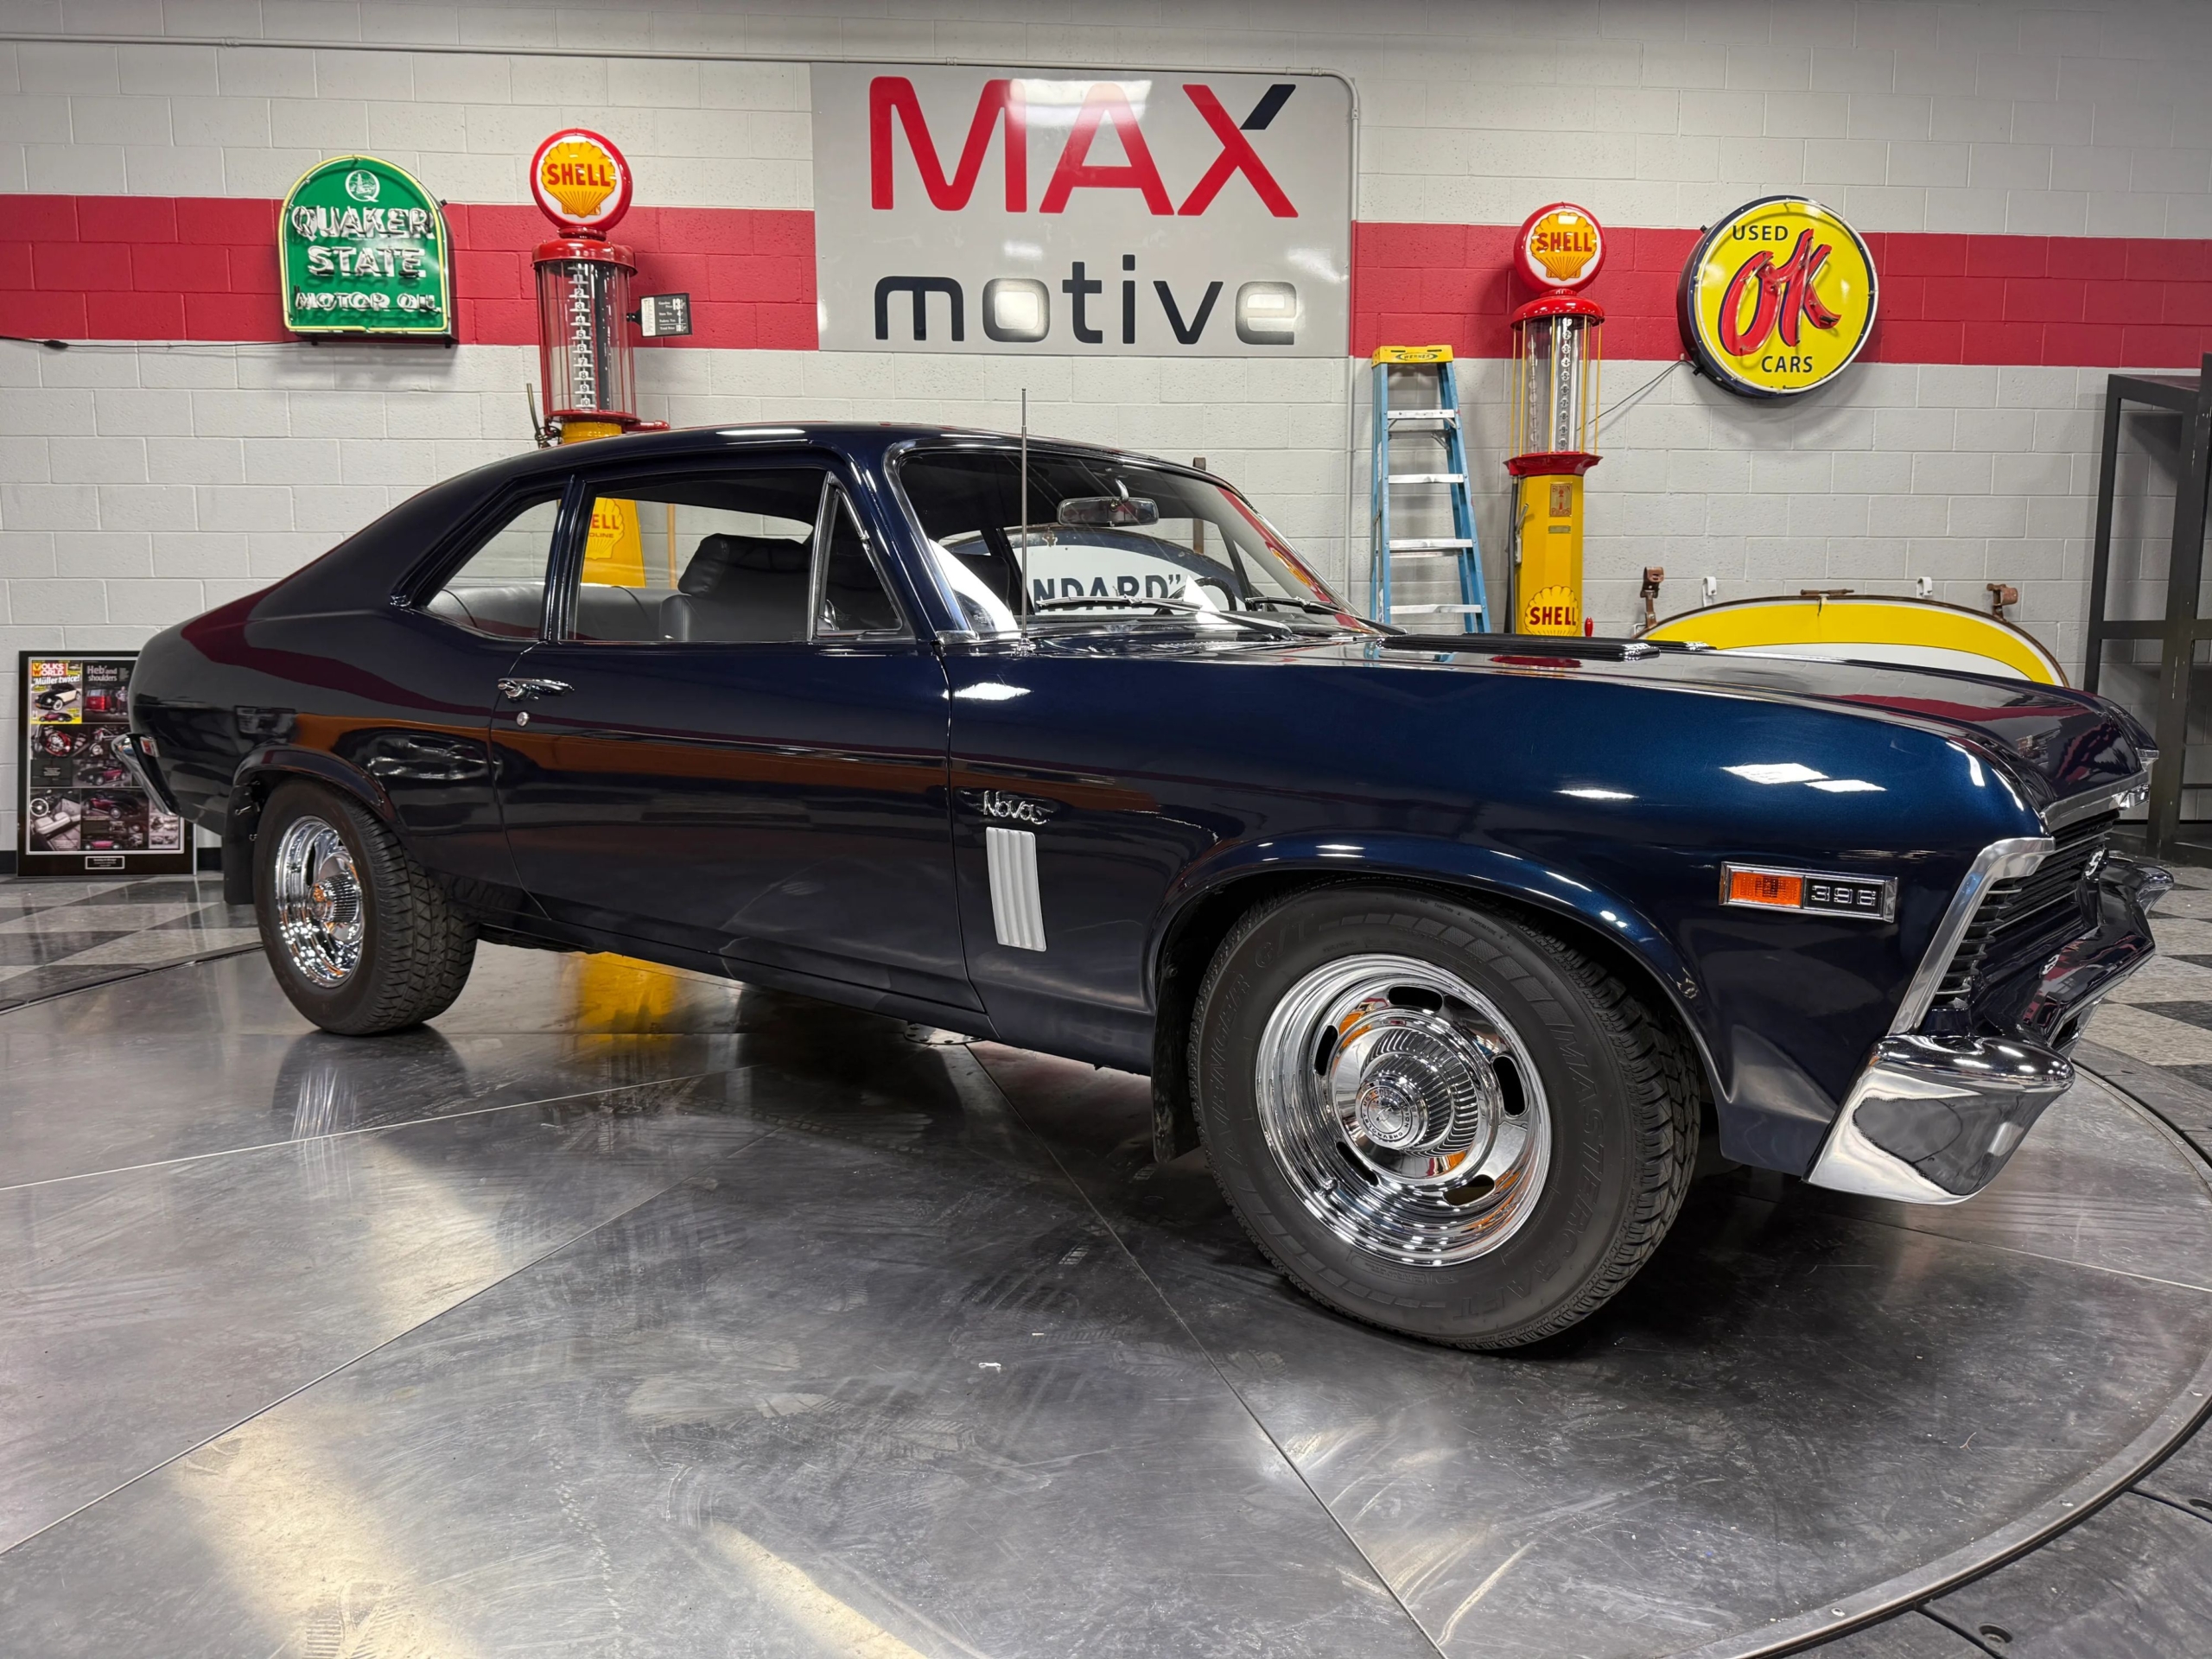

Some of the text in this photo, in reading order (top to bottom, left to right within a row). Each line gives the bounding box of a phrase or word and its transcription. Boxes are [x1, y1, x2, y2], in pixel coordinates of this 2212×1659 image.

[869, 75, 1300, 218] MAX
[547, 163, 611, 187] SHELL
[291, 206, 435, 241] QUAKER
[1732, 225, 1788, 241] USED
[1536, 232, 1592, 252] SHELL
[308, 245, 426, 277] STATE
[296, 292, 442, 312] MOTOR OIL
[874, 254, 1297, 346] motive
[1761, 355, 1813, 373] CARS
[1529, 606, 1576, 626] SHELL
[983, 790, 1048, 824] Nova
[1811, 885, 1877, 906] 396
